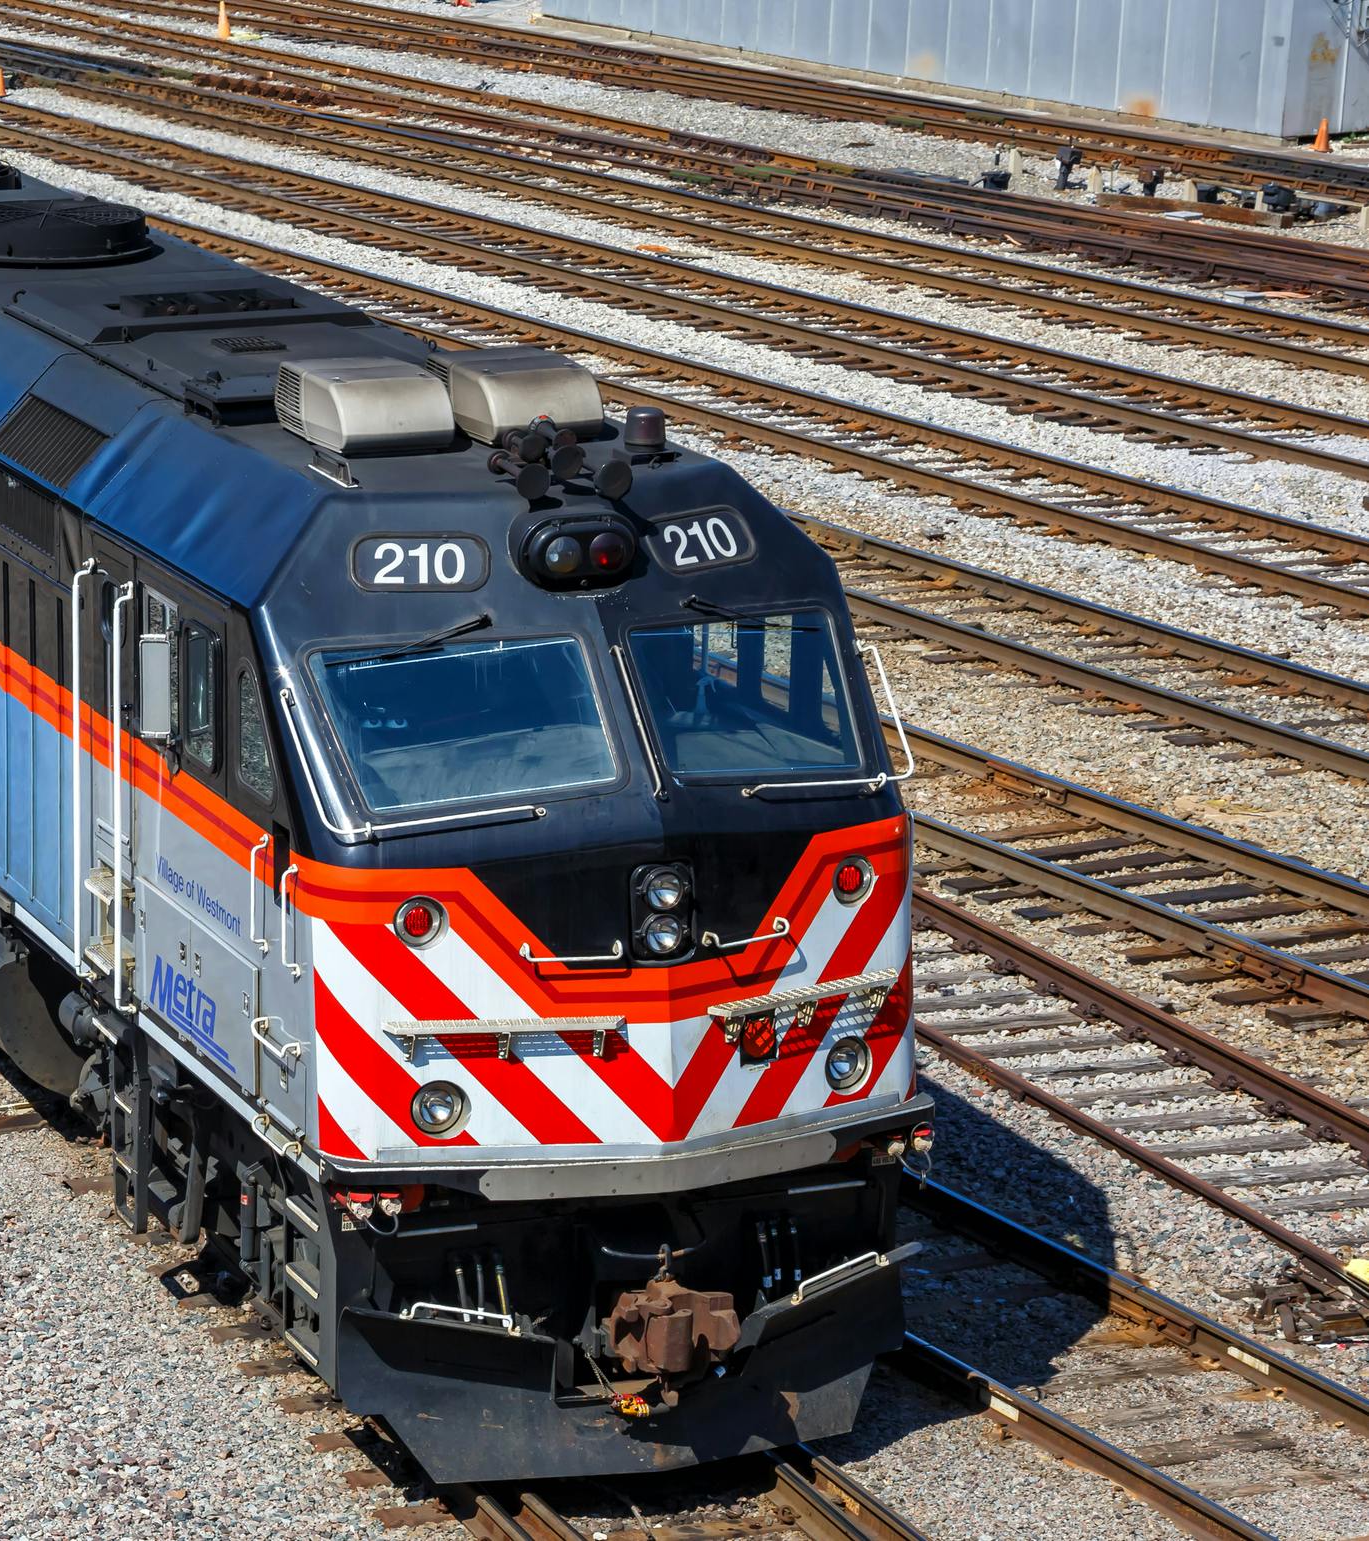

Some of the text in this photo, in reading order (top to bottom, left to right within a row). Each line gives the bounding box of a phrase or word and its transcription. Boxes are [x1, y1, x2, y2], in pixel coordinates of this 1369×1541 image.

[373, 542, 466, 585] 210
[663, 516, 738, 567] 210
[155, 852, 241, 937] Village of Westmont
[150, 953, 217, 1040] Metra
[319, 1158, 326, 1176] F
